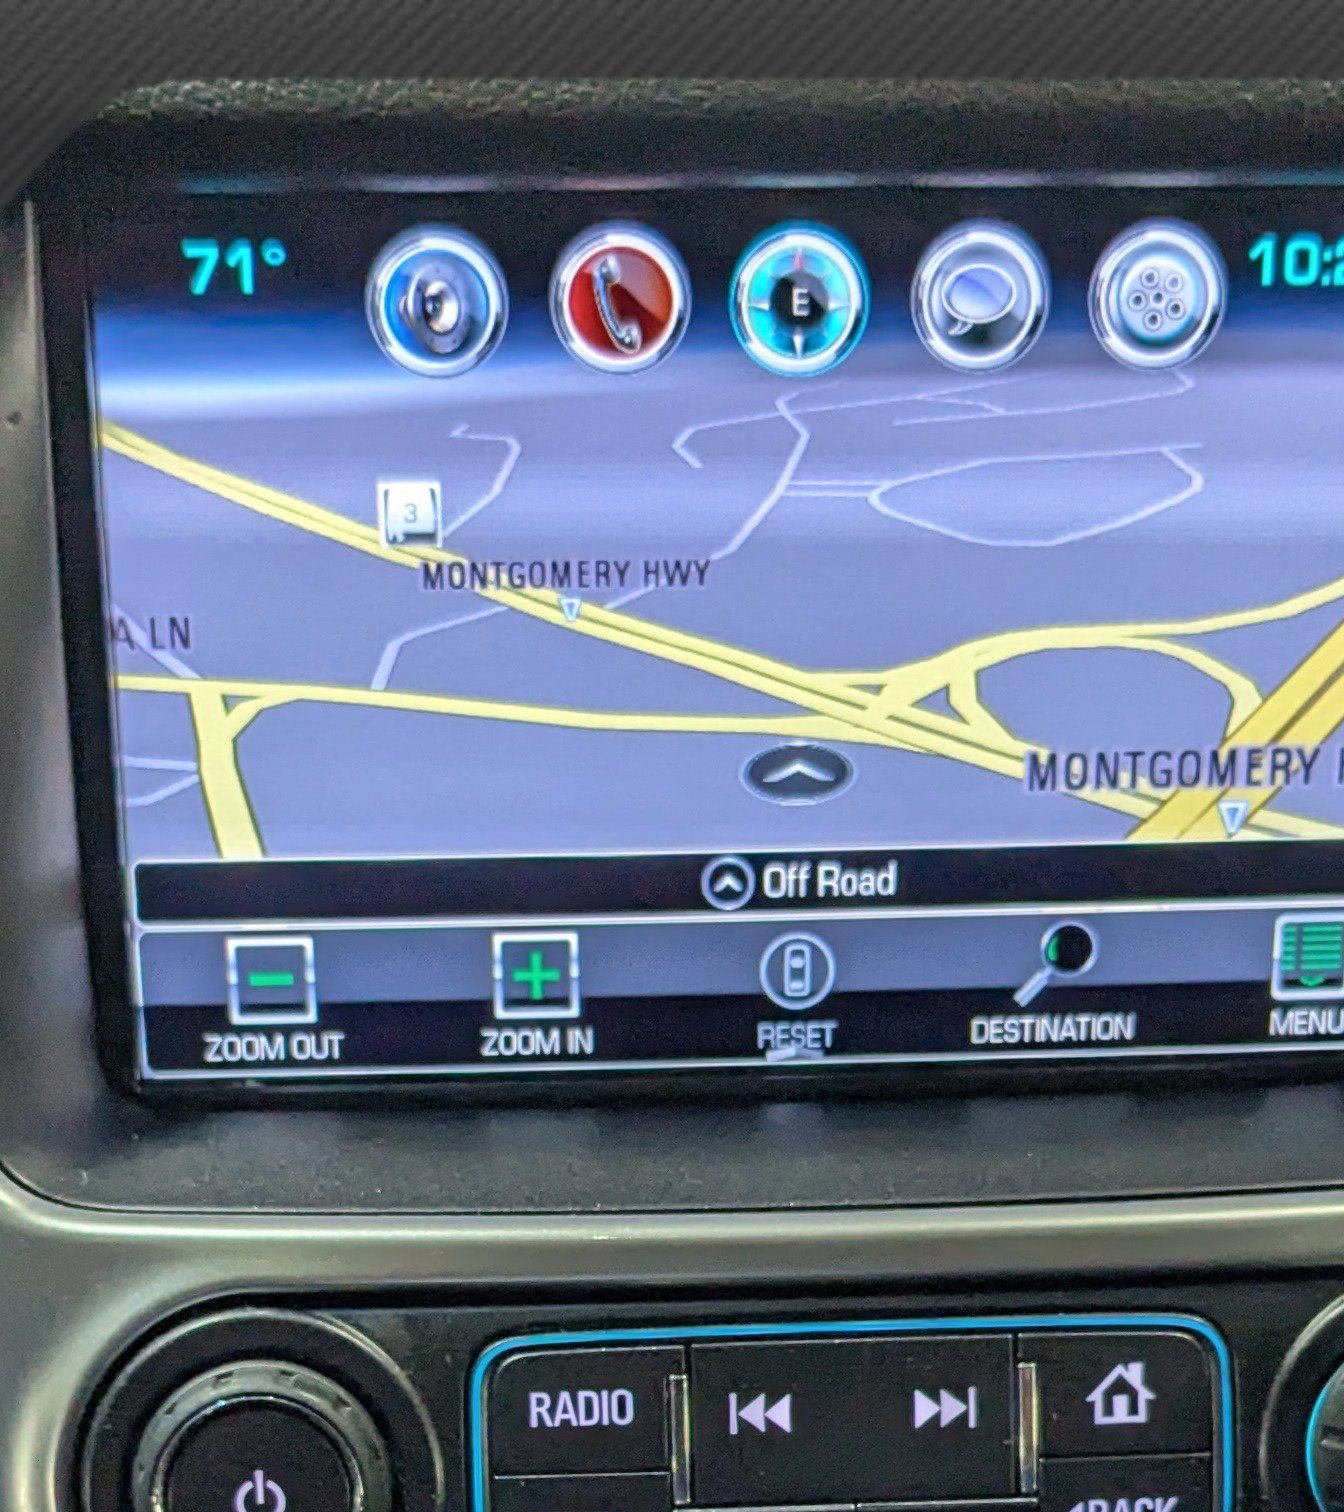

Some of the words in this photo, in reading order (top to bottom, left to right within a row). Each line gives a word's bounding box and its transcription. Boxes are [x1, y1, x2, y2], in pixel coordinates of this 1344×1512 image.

[403, 503, 418, 524] 3
[422, 560, 630, 590] MONTGOMERY
[643, 560, 710, 587] HWY
[150, 616, 190, 650] LN
[1030, 749, 1319, 789] MONTGOMERY
[763, 861, 811, 898] Off
[817, 860, 898, 897] Road
[481, 1028, 560, 1056] ZOOM
[567, 1027, 594, 1054] IN
[757, 1020, 839, 1049] RESET
[971, 1013, 1136, 1044] DESTINATION
[204, 1033, 285, 1062] ZOOM
[290, 1032, 345, 1060] OUT
[529, 1389, 633, 1428] RADIO
